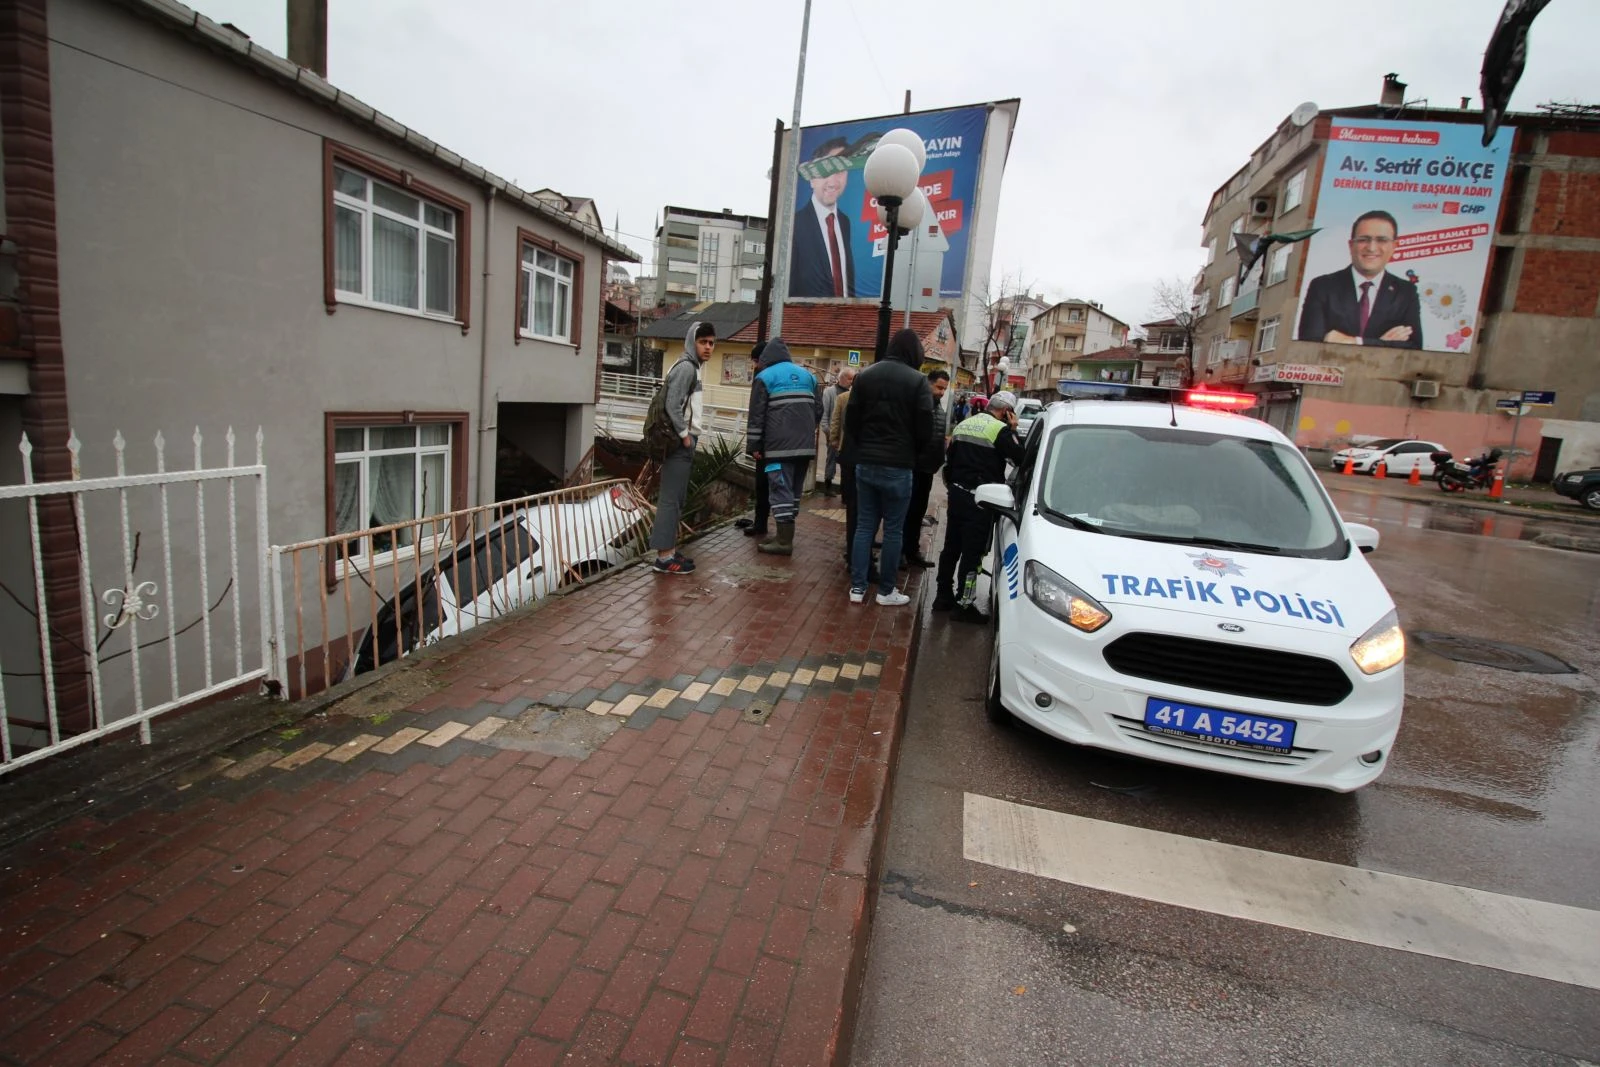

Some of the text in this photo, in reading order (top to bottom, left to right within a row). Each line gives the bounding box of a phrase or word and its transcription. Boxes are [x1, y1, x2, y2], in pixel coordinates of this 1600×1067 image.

[1340, 155, 1495, 183] Av. Sertif GÖKÇE
[1333, 176, 1493, 197] DERİNCE BELEDİYE BAŞKAN ADAYI
[1460, 204, 1485, 214] CHP
[1433, 242, 1471, 254] ALACAK
[1278, 371, 1340, 383] DONDURMA
[1102, 574, 1345, 628] TRAFİK POLİSİ
[1155, 706, 1284, 742] 41 A 5452
